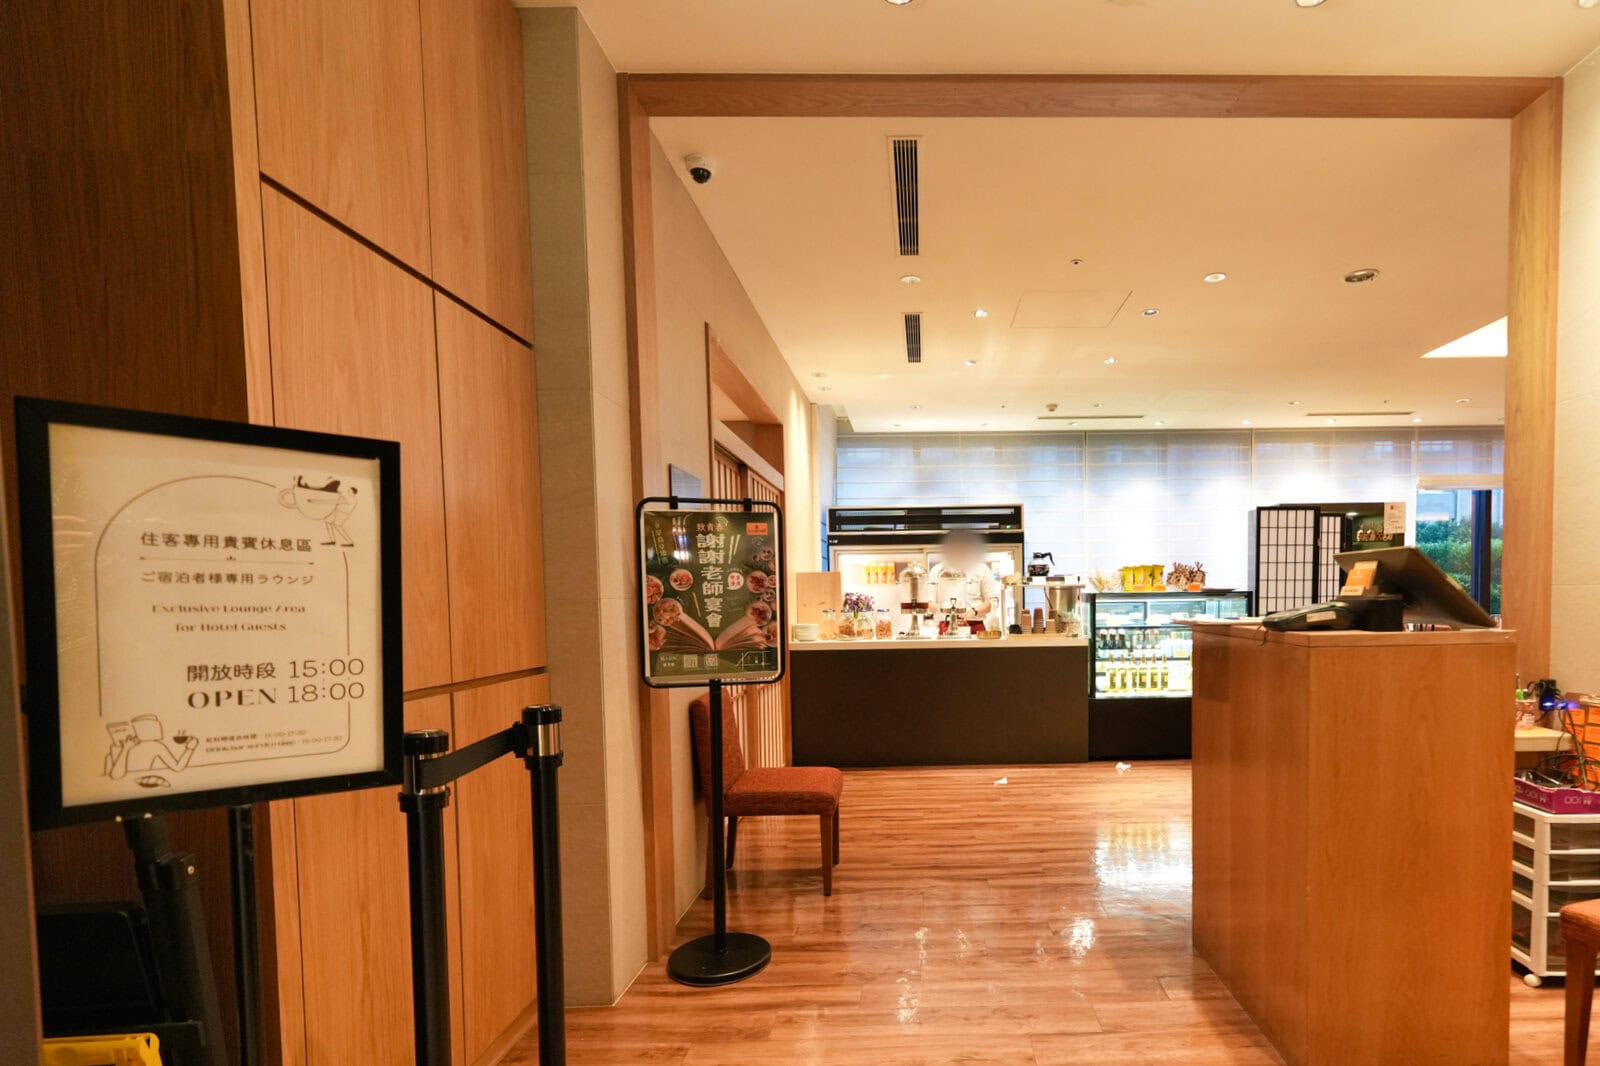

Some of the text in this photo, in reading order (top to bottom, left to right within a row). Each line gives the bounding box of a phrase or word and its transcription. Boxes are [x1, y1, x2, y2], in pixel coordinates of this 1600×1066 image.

[141, 532, 312, 552] 住客專用貴賓休息區
[696, 533, 725, 628] 謝謝老師宴會
[151, 603, 220, 614] Exclusive
[223, 604, 272, 615] Lounge
[200, 622, 238, 632] Hotel
[241, 622, 287, 632] Guests
[187, 658, 365, 681] 開放時段 15:00
[188, 681, 365, 708] OPEN 18:00
